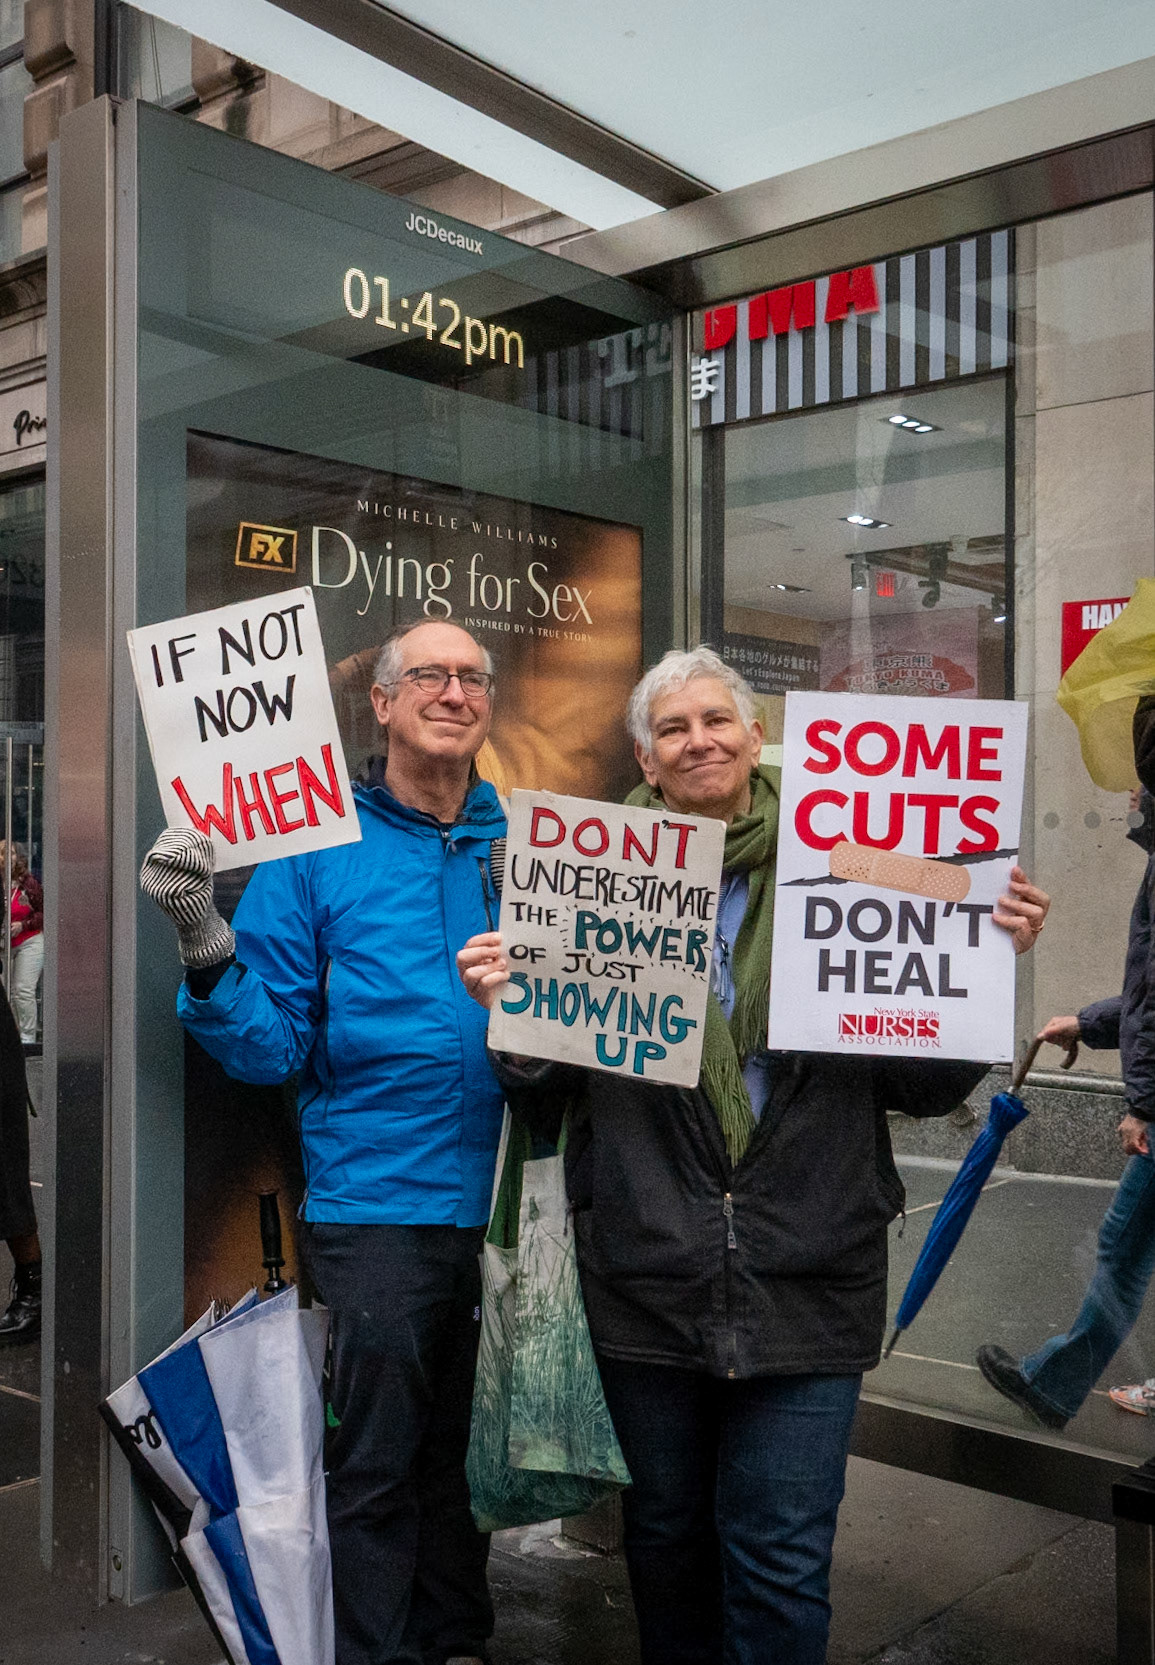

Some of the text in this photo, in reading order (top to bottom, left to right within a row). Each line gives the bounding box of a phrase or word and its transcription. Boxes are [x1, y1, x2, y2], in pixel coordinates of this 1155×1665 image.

[405, 213, 483, 256] JCDecaux
[343, 267, 524, 368] 01:42pm
[13, 410, 47, 446] Pri
[249, 532, 285, 564] FX
[357, 500, 558, 549] MICHELLE WILLIAMS
[312, 525, 593, 625] Dying for Sex
[151, 604, 304, 688] IF NOT
[465, 617, 592, 643] INSPIRED BY A TRUE STORY
[194, 674, 296, 742] NOW
[803, 718, 1004, 782] SOME
[170, 742, 346, 844] WHEN
[528, 806, 698, 870] DON'T
[794, 788, 1000, 854] CUTS
[511, 854, 716, 921] UNDERESTIMATE
[509, 902, 708, 973] THE POWER
[804, 896, 994, 948] DON'T
[509, 944, 644, 982] OF JUST
[818, 948, 968, 998] HEAL
[500, 971, 697, 1044] SHOWING
[838, 1013, 940, 1039] NURSES
[874, 1006, 940, 1018] New York State
[596, 1033, 668, 1076] UP
[838, 1035, 942, 1048] ASSOCIATION
